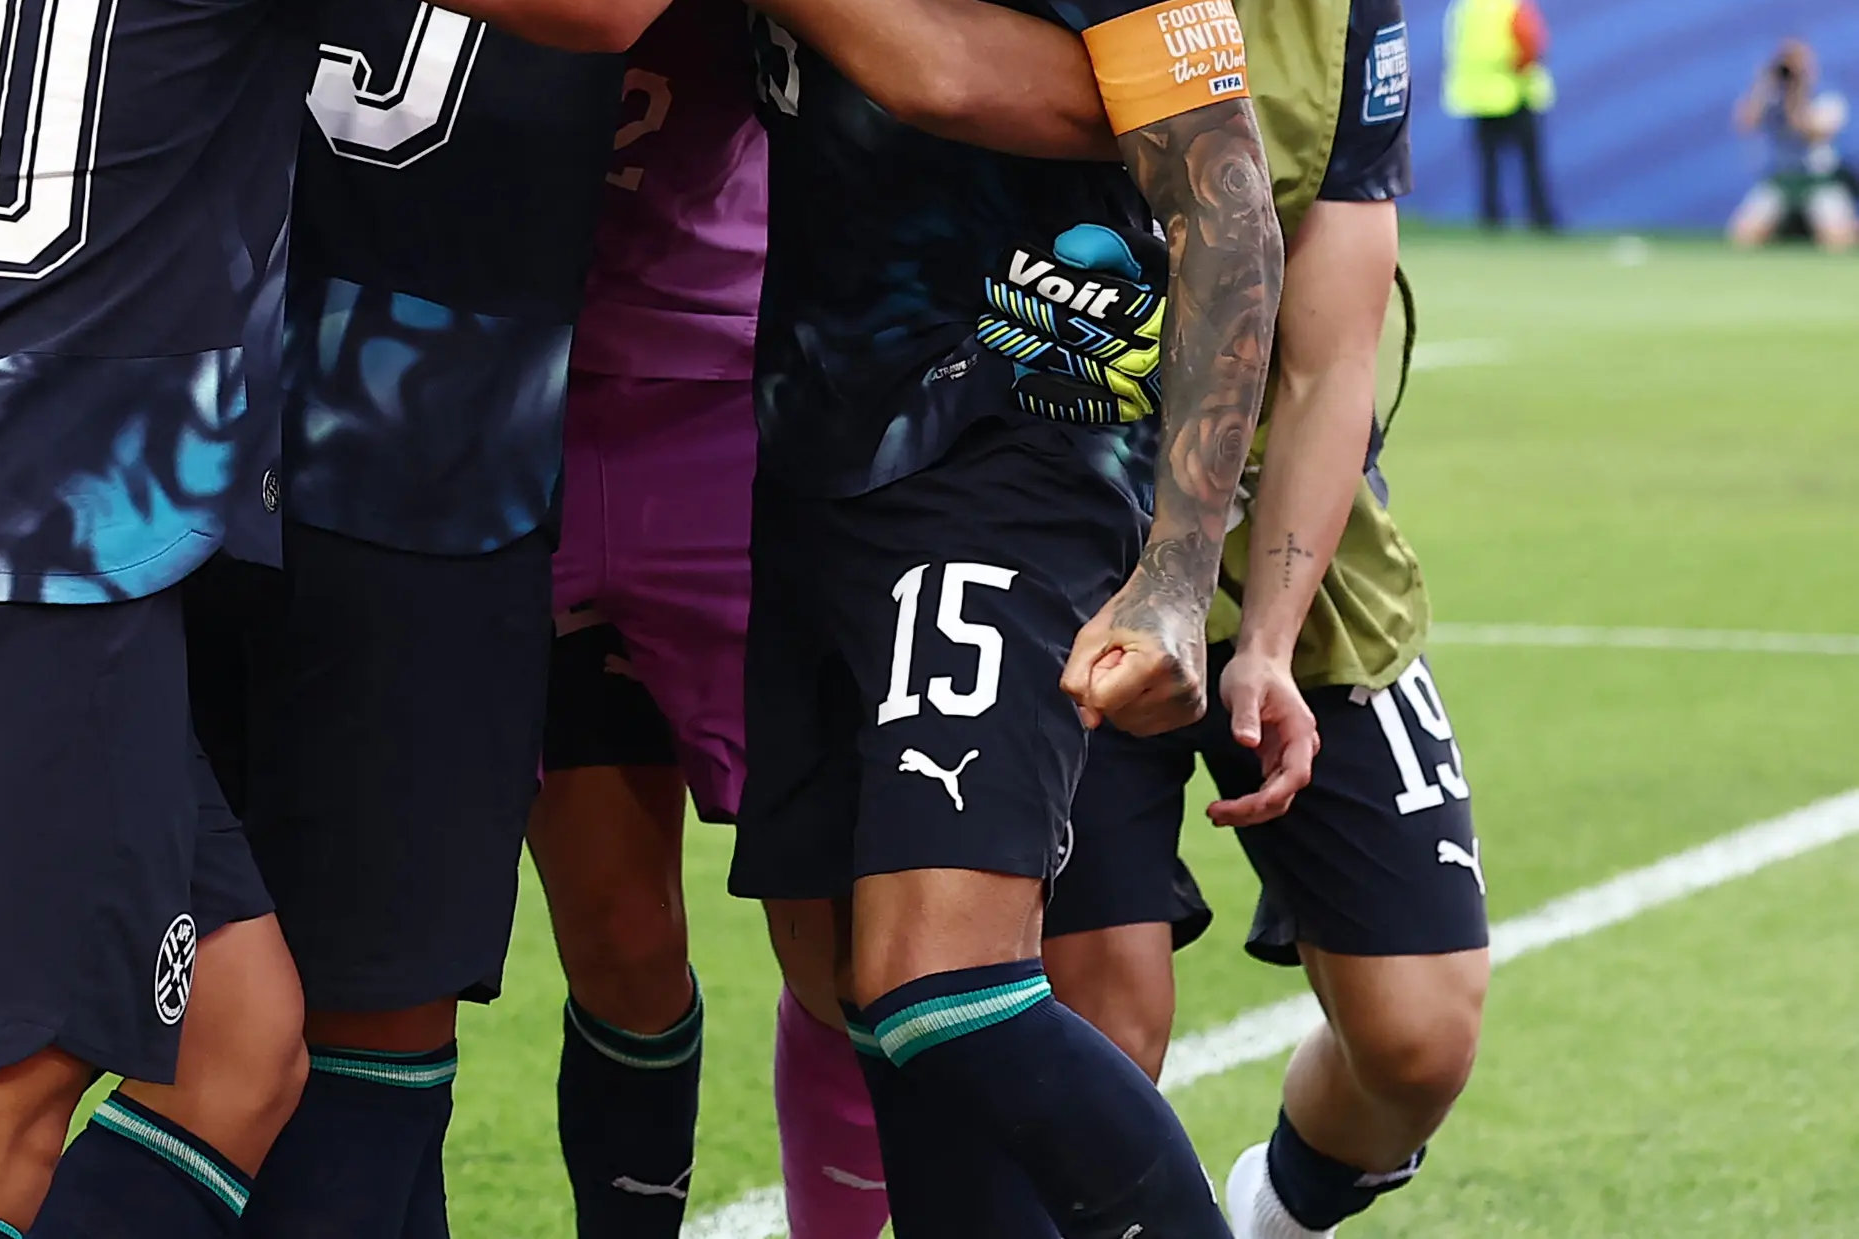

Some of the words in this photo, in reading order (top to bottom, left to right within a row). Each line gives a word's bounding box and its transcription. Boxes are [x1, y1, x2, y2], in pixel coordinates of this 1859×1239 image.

[1164, 18, 1244, 58] UNITE
[1168, 58, 1211, 84] the
[1213, 76, 1241, 92] FIFA
[1009, 249, 1120, 319] Voit
[877, 562, 1019, 726] 15
[1348, 657, 1471, 815] 19
